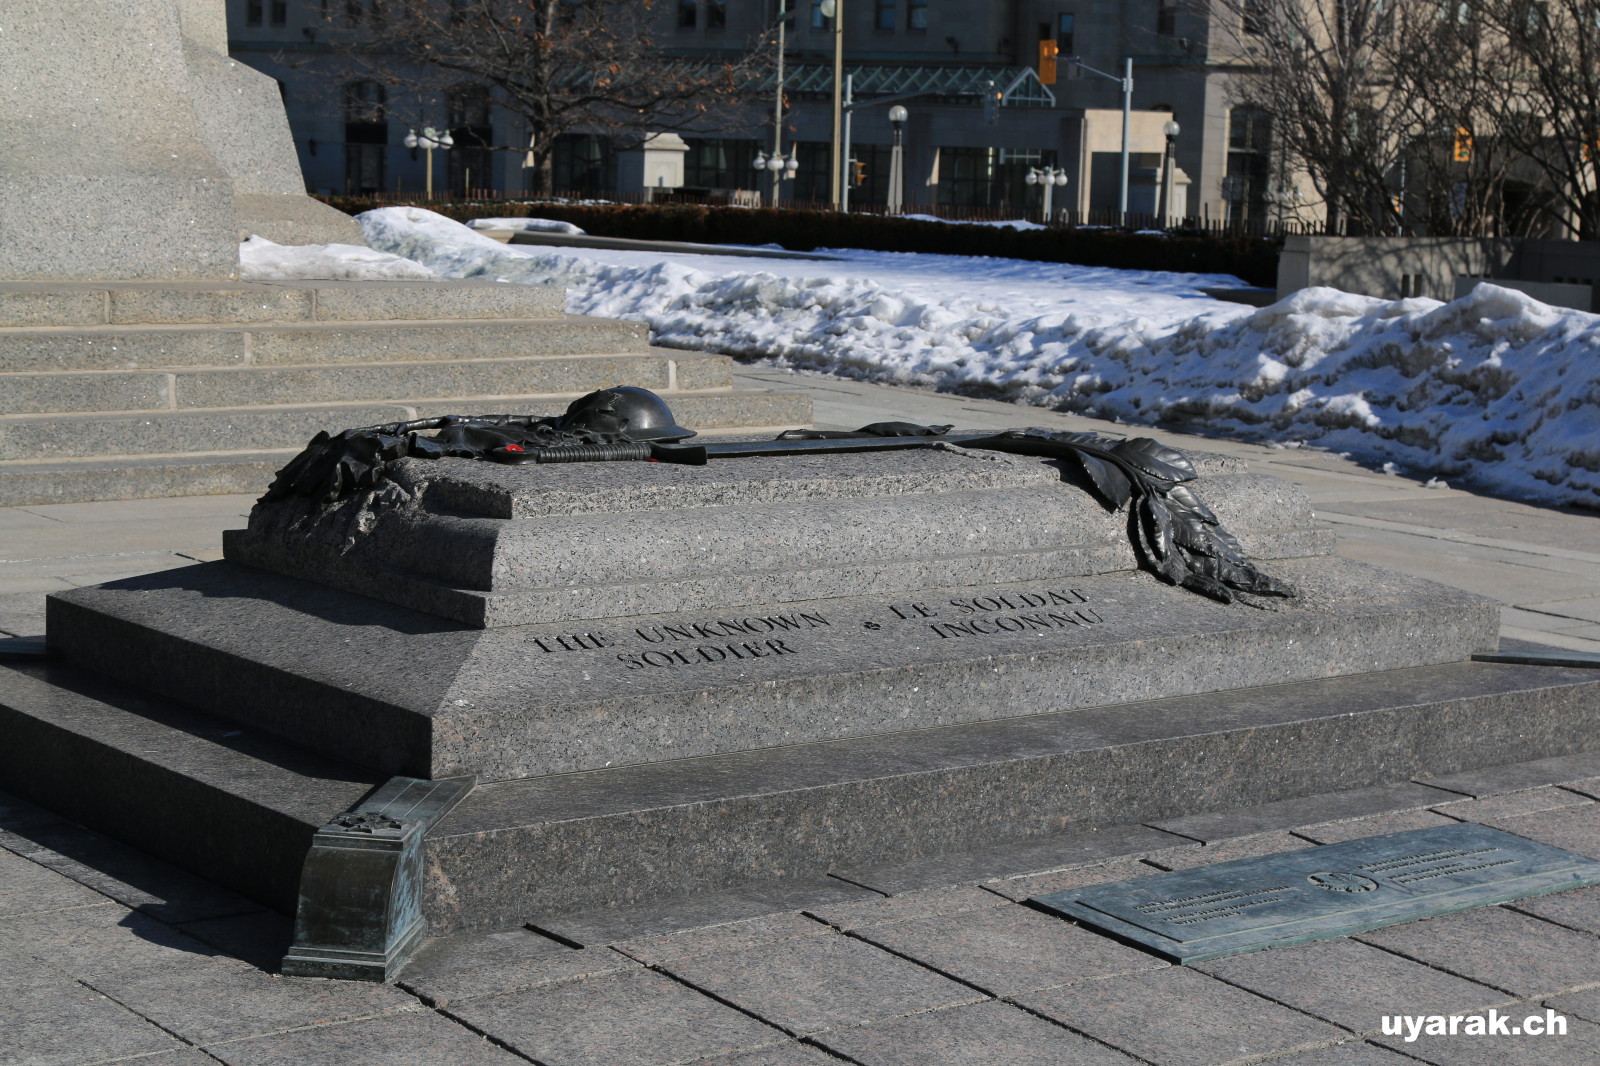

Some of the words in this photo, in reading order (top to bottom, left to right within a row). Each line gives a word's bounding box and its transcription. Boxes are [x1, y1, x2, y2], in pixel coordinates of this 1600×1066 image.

[888, 602, 938, 620] LE
[950, 588, 1088, 614] SOLDAT
[525, 631, 615, 653] THE
[634, 611, 831, 643] UNKNOWN
[926, 608, 1104, 639] INCONNU
[617, 639, 798, 670] SOLDIER
